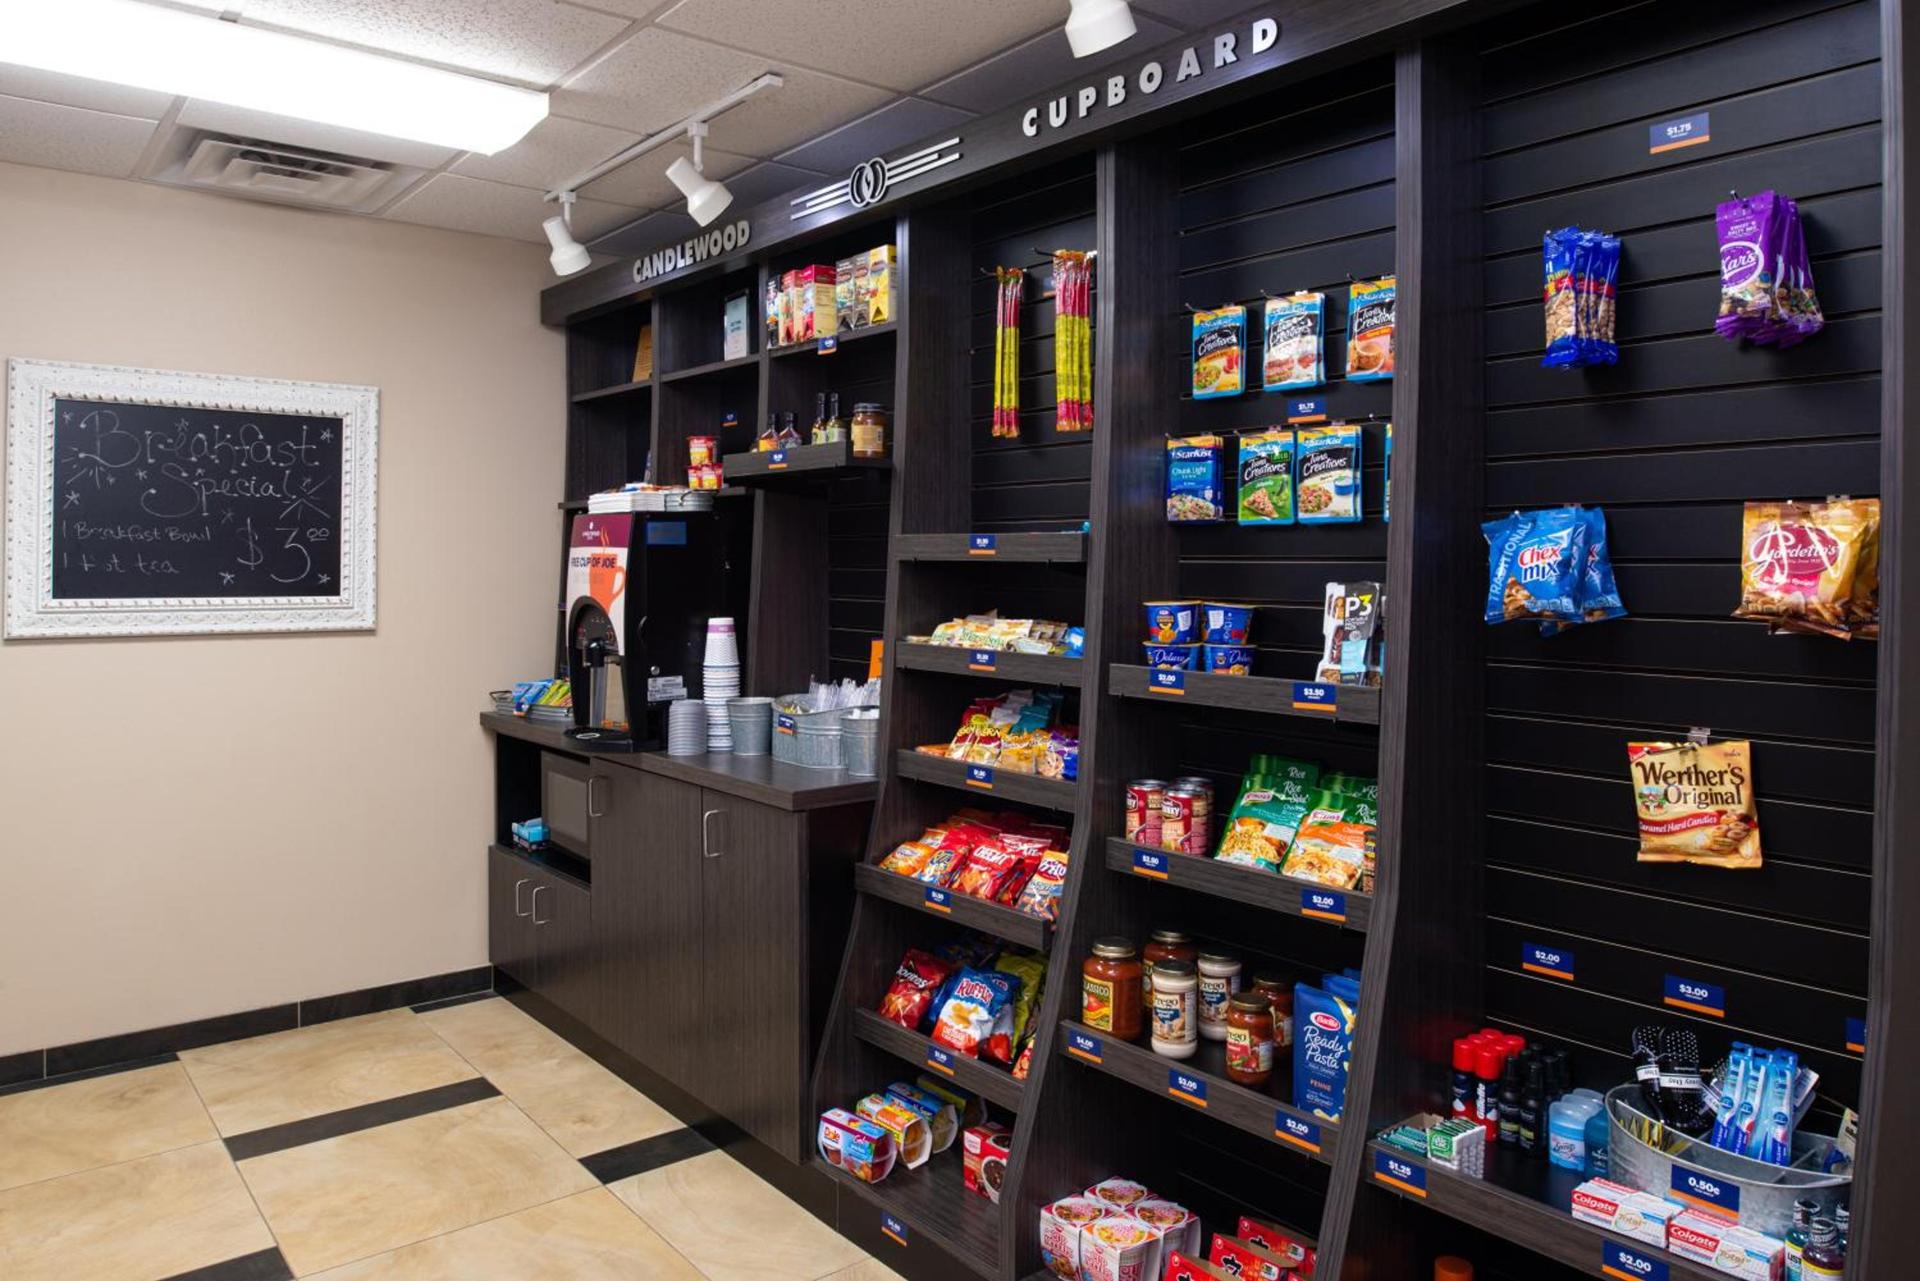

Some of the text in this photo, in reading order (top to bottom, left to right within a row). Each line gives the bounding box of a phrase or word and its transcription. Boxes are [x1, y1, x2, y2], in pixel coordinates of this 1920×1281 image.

[1022, 18, 1278, 137] CUPBOARD
[1666, 122, 1692, 136] $1.75
[633, 220, 750, 283] CANDLEWOOD
[78, 410, 318, 473] Breakfast
[1176, 448, 1213, 459] StarKist
[1244, 463, 1287, 481] Creations
[1303, 458, 1347, 476] Creations
[141, 463, 297, 517] Special
[73, 521, 161, 542] Breakfast
[601, 557, 616, 568] JOE
[1518, 545, 1562, 567] Chex
[1523, 561, 1560, 583] mix
[1345, 594, 1372, 618] P3
[1635, 761, 1745, 787] Werther's
[1664, 783, 1743, 810] Original
[1668, 820, 1687, 832] Hard
[1687, 815, 1718, 828] Candies
[1534, 950, 1560, 963] $2.00
[1679, 984, 1709, 998] $3.00
[1304, 1025, 1347, 1058] Ready
[1305, 1043, 1340, 1069] Pasta
[824, 1126, 841, 1142] Dole
[1388, 1160, 1412, 1175] $1.25
[1573, 1192, 1616, 1213] Colgate
[1670, 1226, 1718, 1249] Colgate
[1618, 1251, 1652, 1272] $2.00
